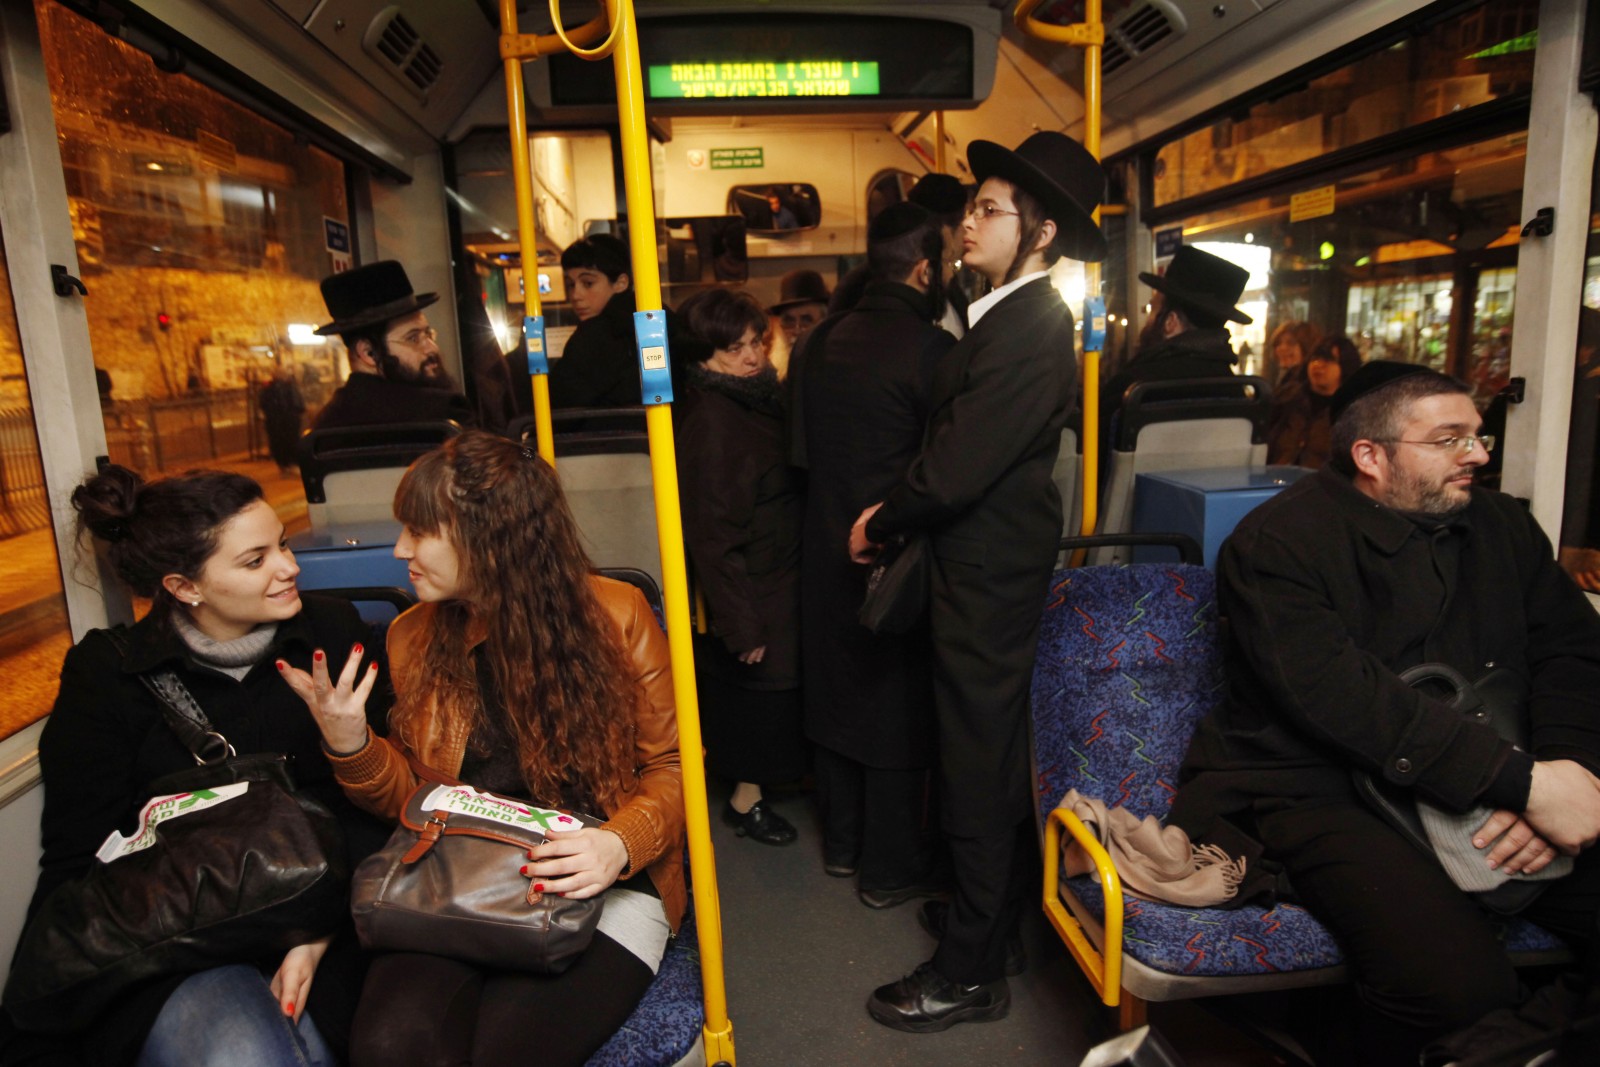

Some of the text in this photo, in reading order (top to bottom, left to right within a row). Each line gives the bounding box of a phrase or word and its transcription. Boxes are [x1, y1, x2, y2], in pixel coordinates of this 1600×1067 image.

[672, 64, 716, 81] הבאה
[721, 64, 776, 81] בתחנה
[793, 79, 850, 95] שמואל
[646, 354, 662, 362] STOP
[448, 799, 513, 822] מאחור!
